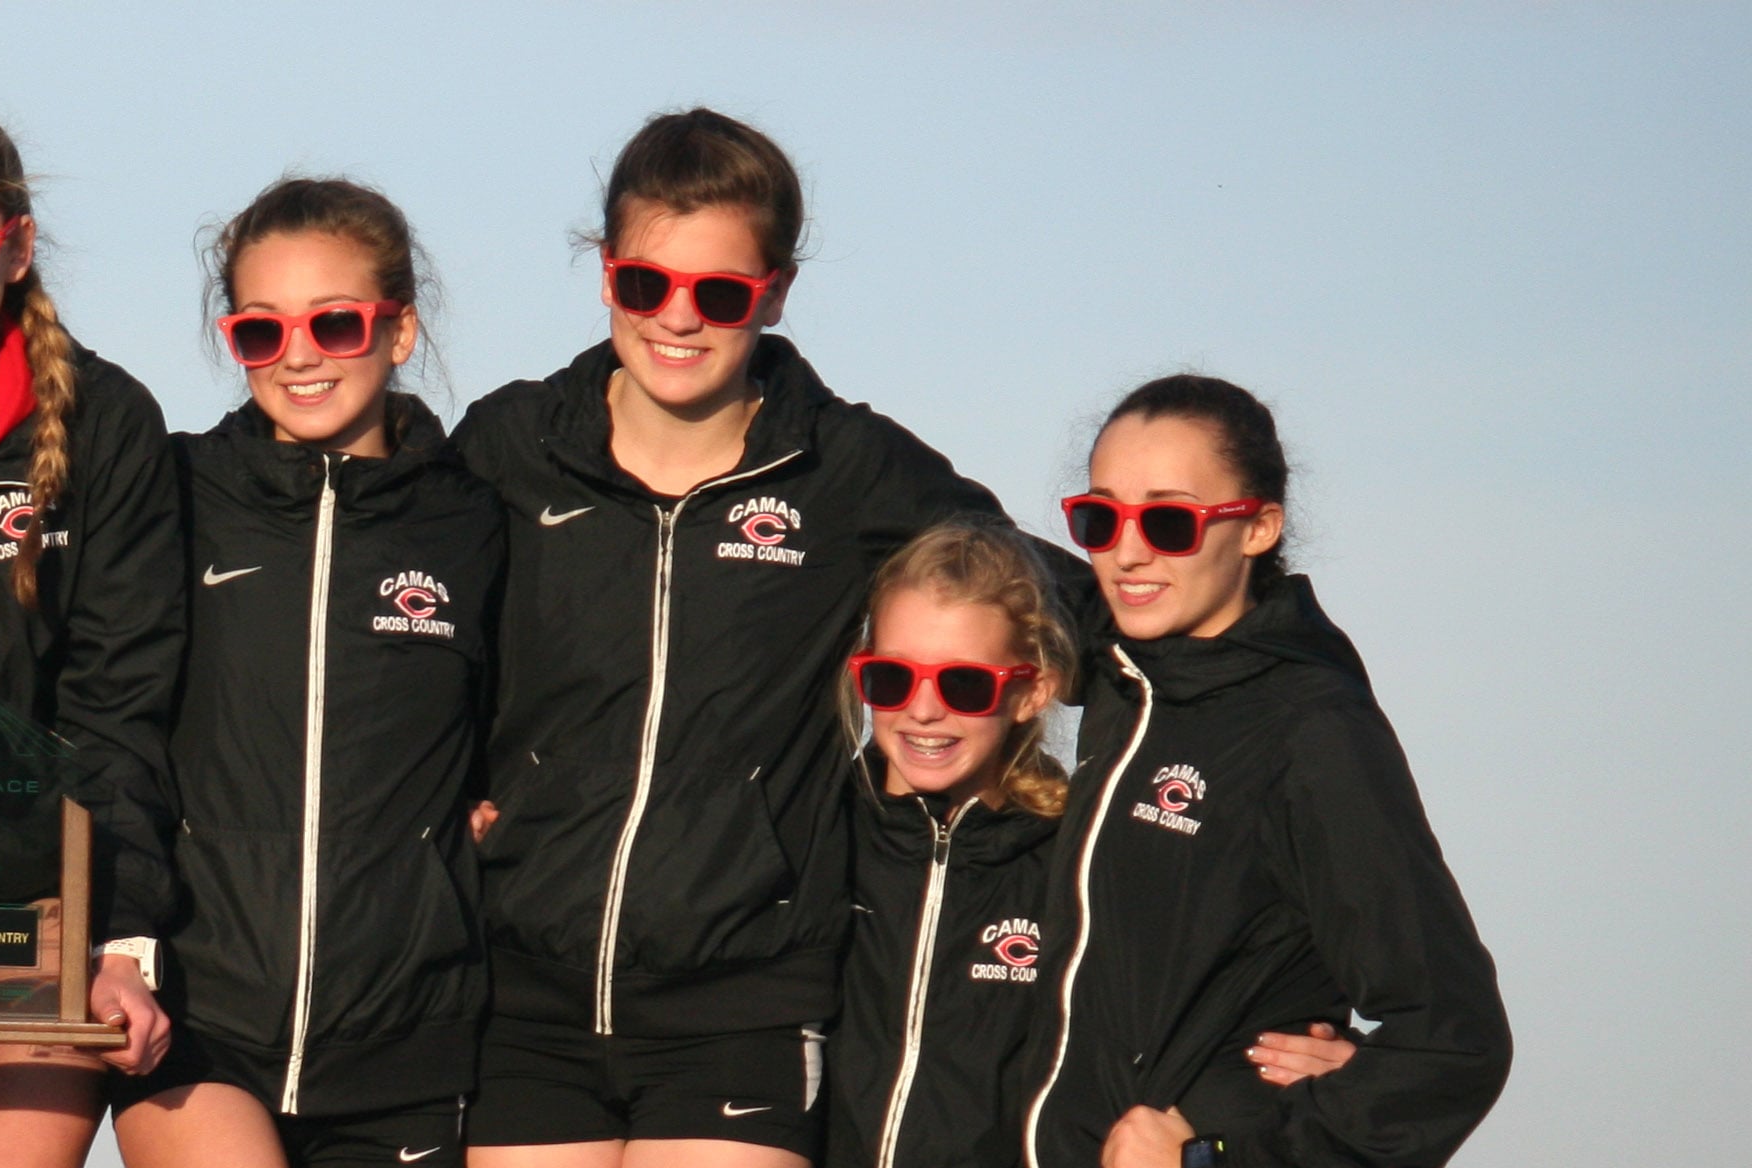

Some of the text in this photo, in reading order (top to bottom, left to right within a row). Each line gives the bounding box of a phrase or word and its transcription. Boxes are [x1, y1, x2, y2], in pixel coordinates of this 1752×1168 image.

[728, 496, 801, 529] CAMAS
[41, 530, 69, 549] NTRY
[717, 542, 806, 566] CROSS COUNTRY
[379, 570, 450, 602] CAMAS
[373, 615, 456, 638] CROSS COUNTRY
[1152, 764, 1207, 800] CAMAS
[1133, 802, 1202, 835] CROSS COUNTRY
[971, 964, 1008, 980] CROSS
